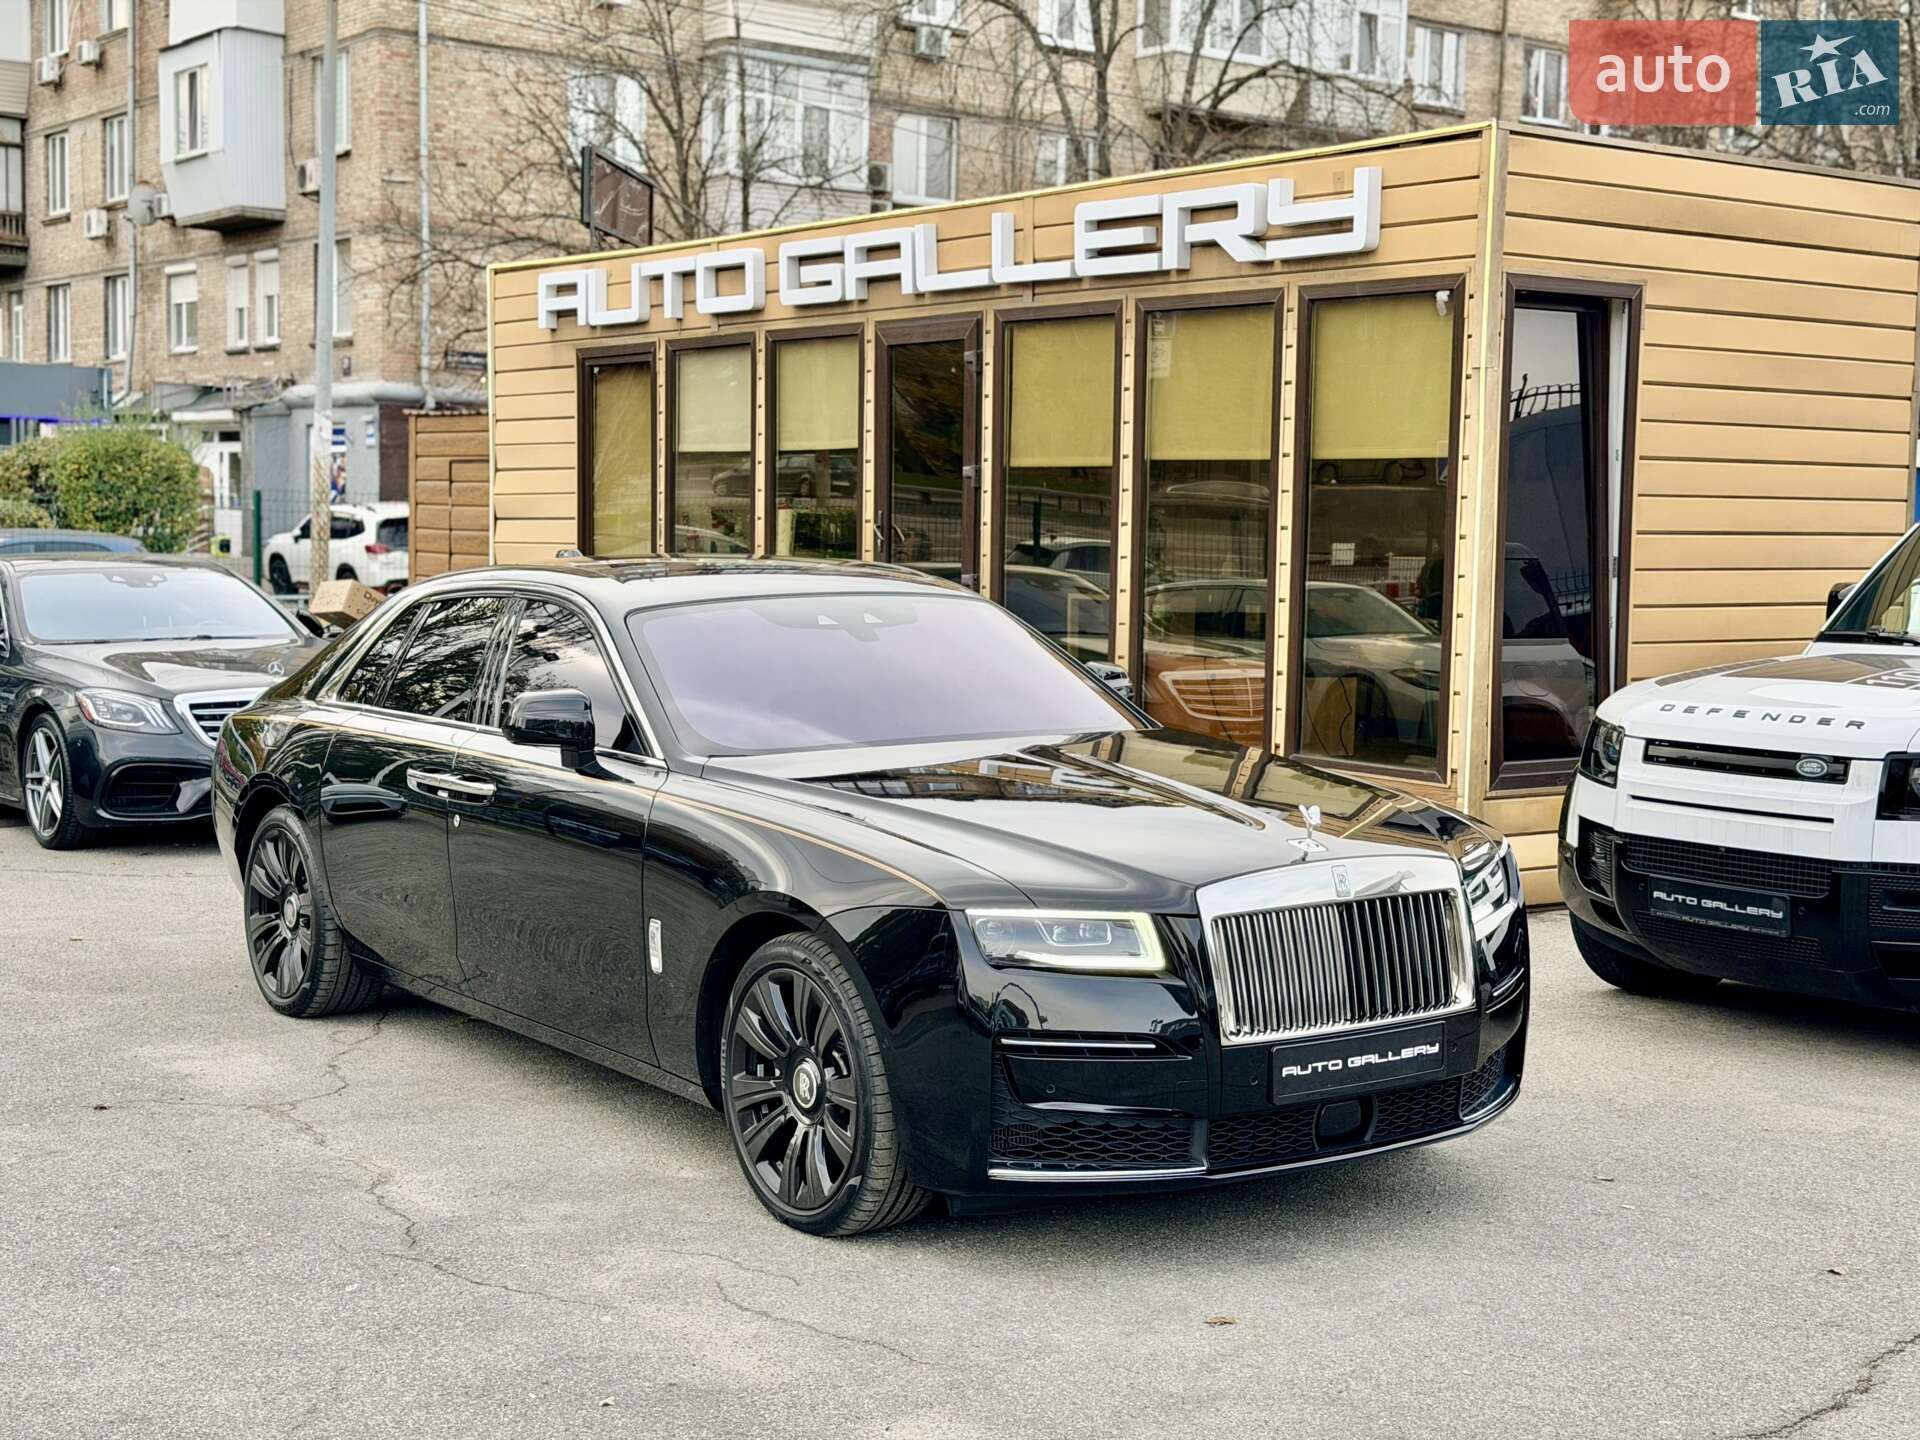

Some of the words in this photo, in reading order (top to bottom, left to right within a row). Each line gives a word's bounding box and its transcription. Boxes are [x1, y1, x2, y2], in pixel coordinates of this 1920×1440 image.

[537, 246, 766, 330] AUTO
[779, 166, 1382, 305] GALLERY
[1660, 703, 1866, 730] DEFENDER
[1652, 890, 1698, 906] AUTO
[1701, 899, 1783, 919] GALLERY
[1282, 1059, 1342, 1077] AUTO
[1347, 1043, 1440, 1068] GALLERY
